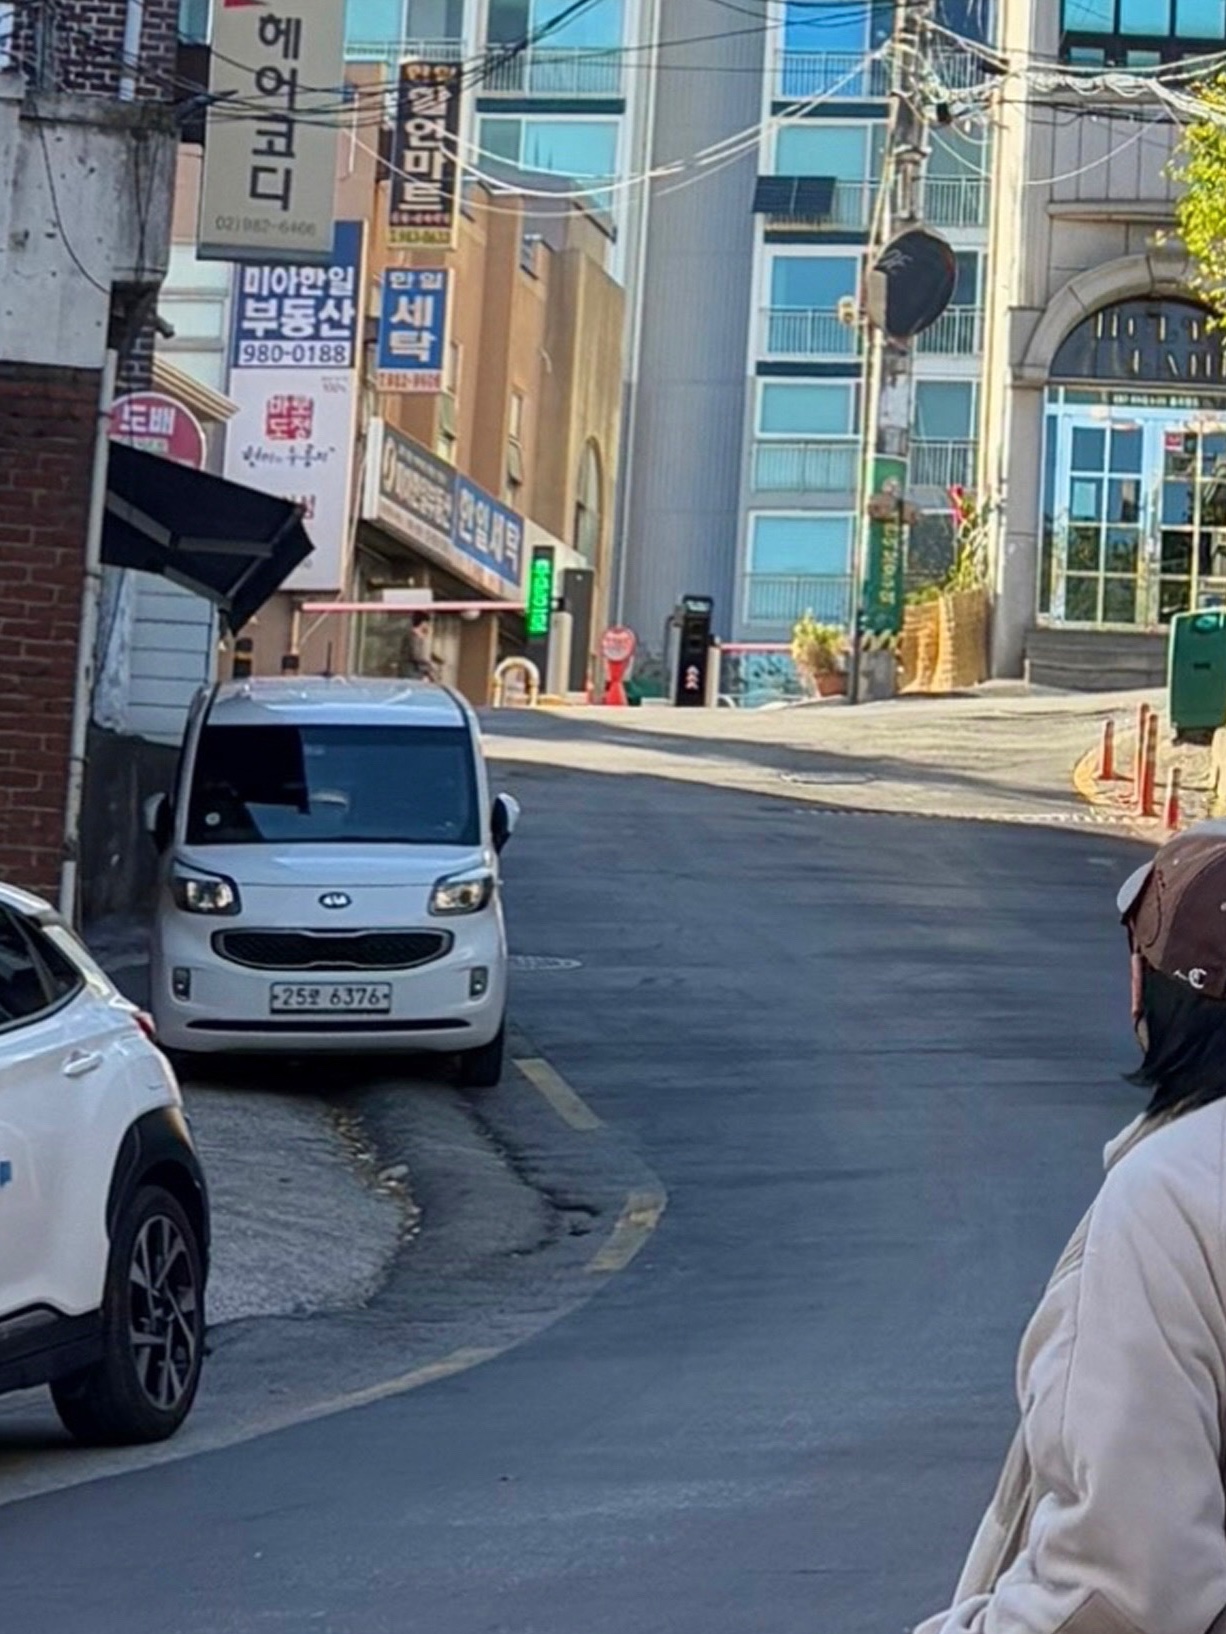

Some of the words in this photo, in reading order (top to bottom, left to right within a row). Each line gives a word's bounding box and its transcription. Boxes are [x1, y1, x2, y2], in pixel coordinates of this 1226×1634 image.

[250, 13, 302, 212] 헤어코디
[243, 266, 355, 296] 미아한일
[242, 298, 355, 338] 부동산
[389, 295, 437, 362] 세탁
[243, 343, 346, 363] 980-0188
[329, 987, 380, 1006] 6376
